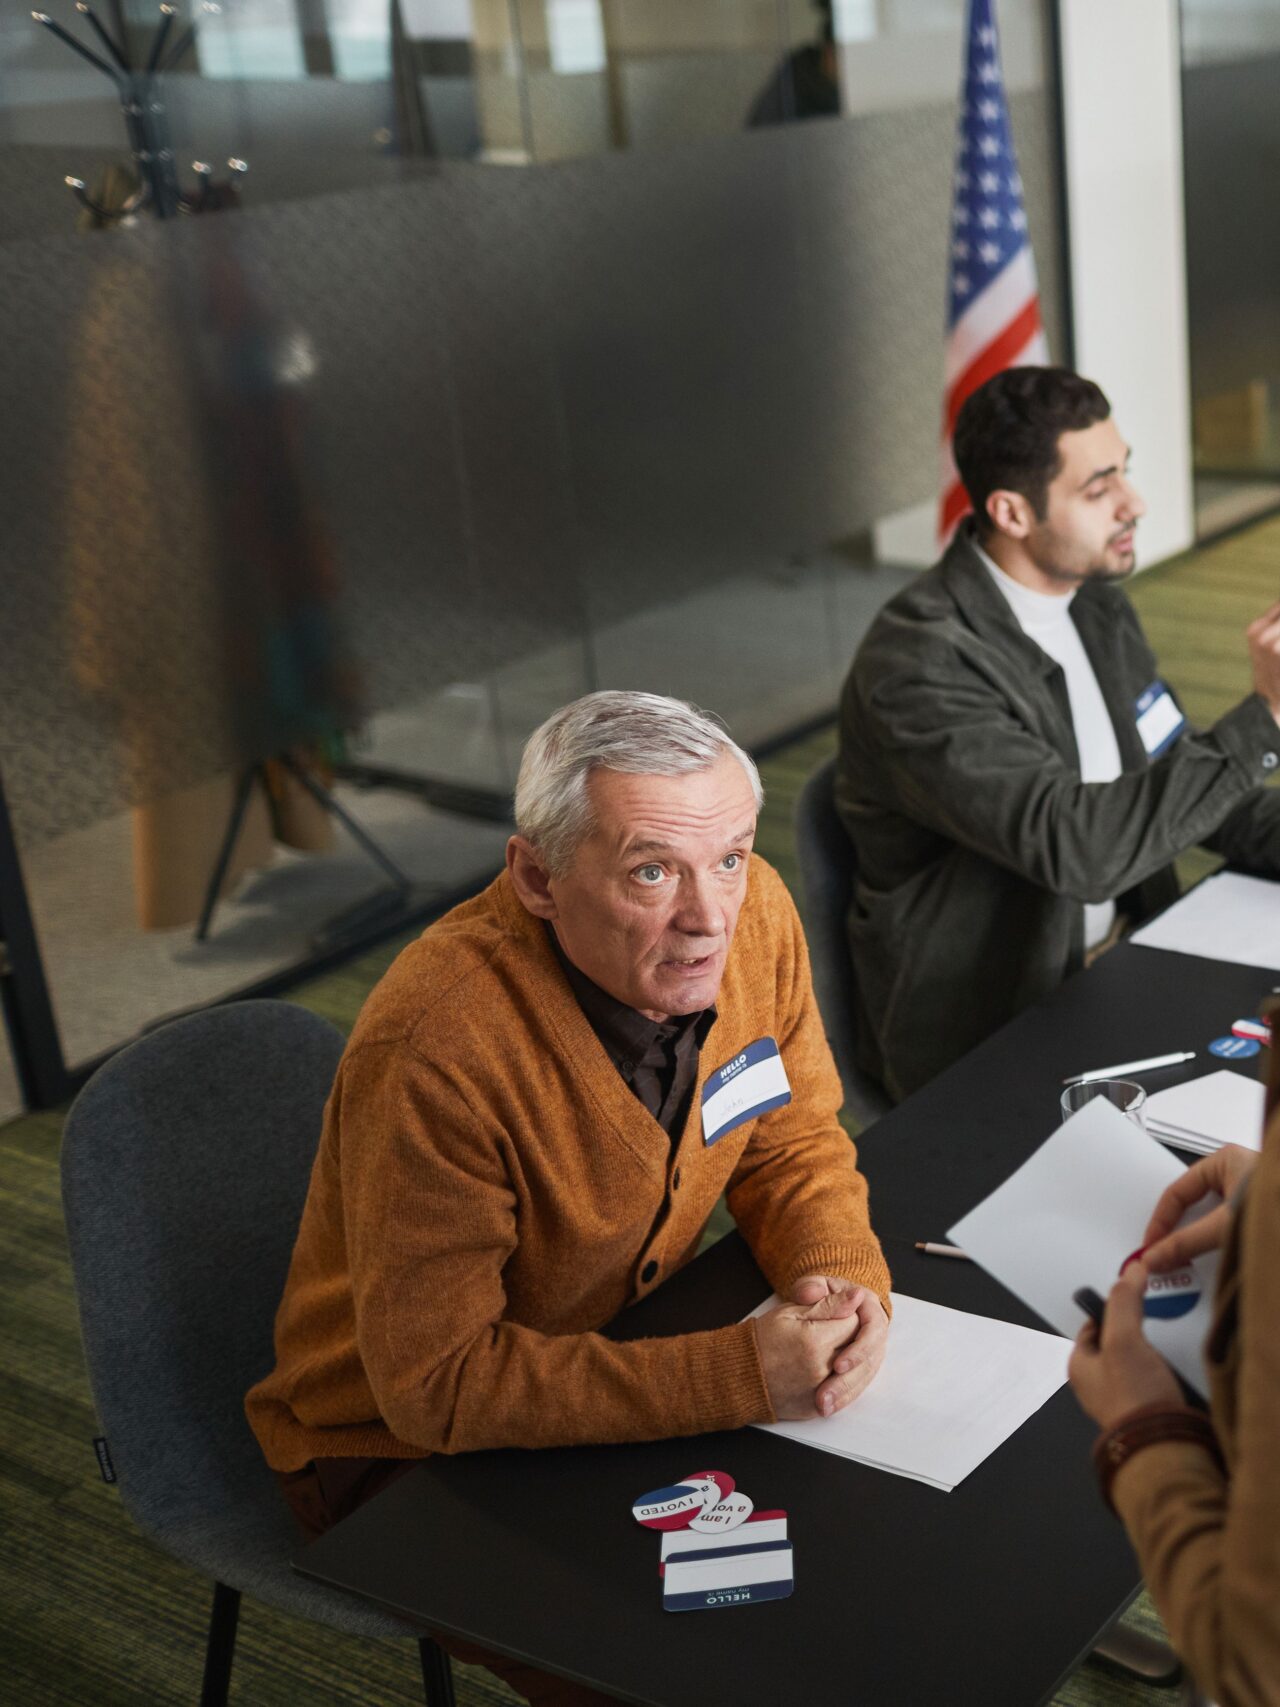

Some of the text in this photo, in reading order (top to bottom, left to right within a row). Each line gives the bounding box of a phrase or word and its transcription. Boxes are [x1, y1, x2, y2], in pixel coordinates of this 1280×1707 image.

[720, 1054, 747, 1078] HELLO
[641, 1497, 694, 1516] I VOTED
[711, 1504, 733, 1512] vot
[701, 1514, 731, 1524] I am
[706, 1592, 750, 1605] HELLO
